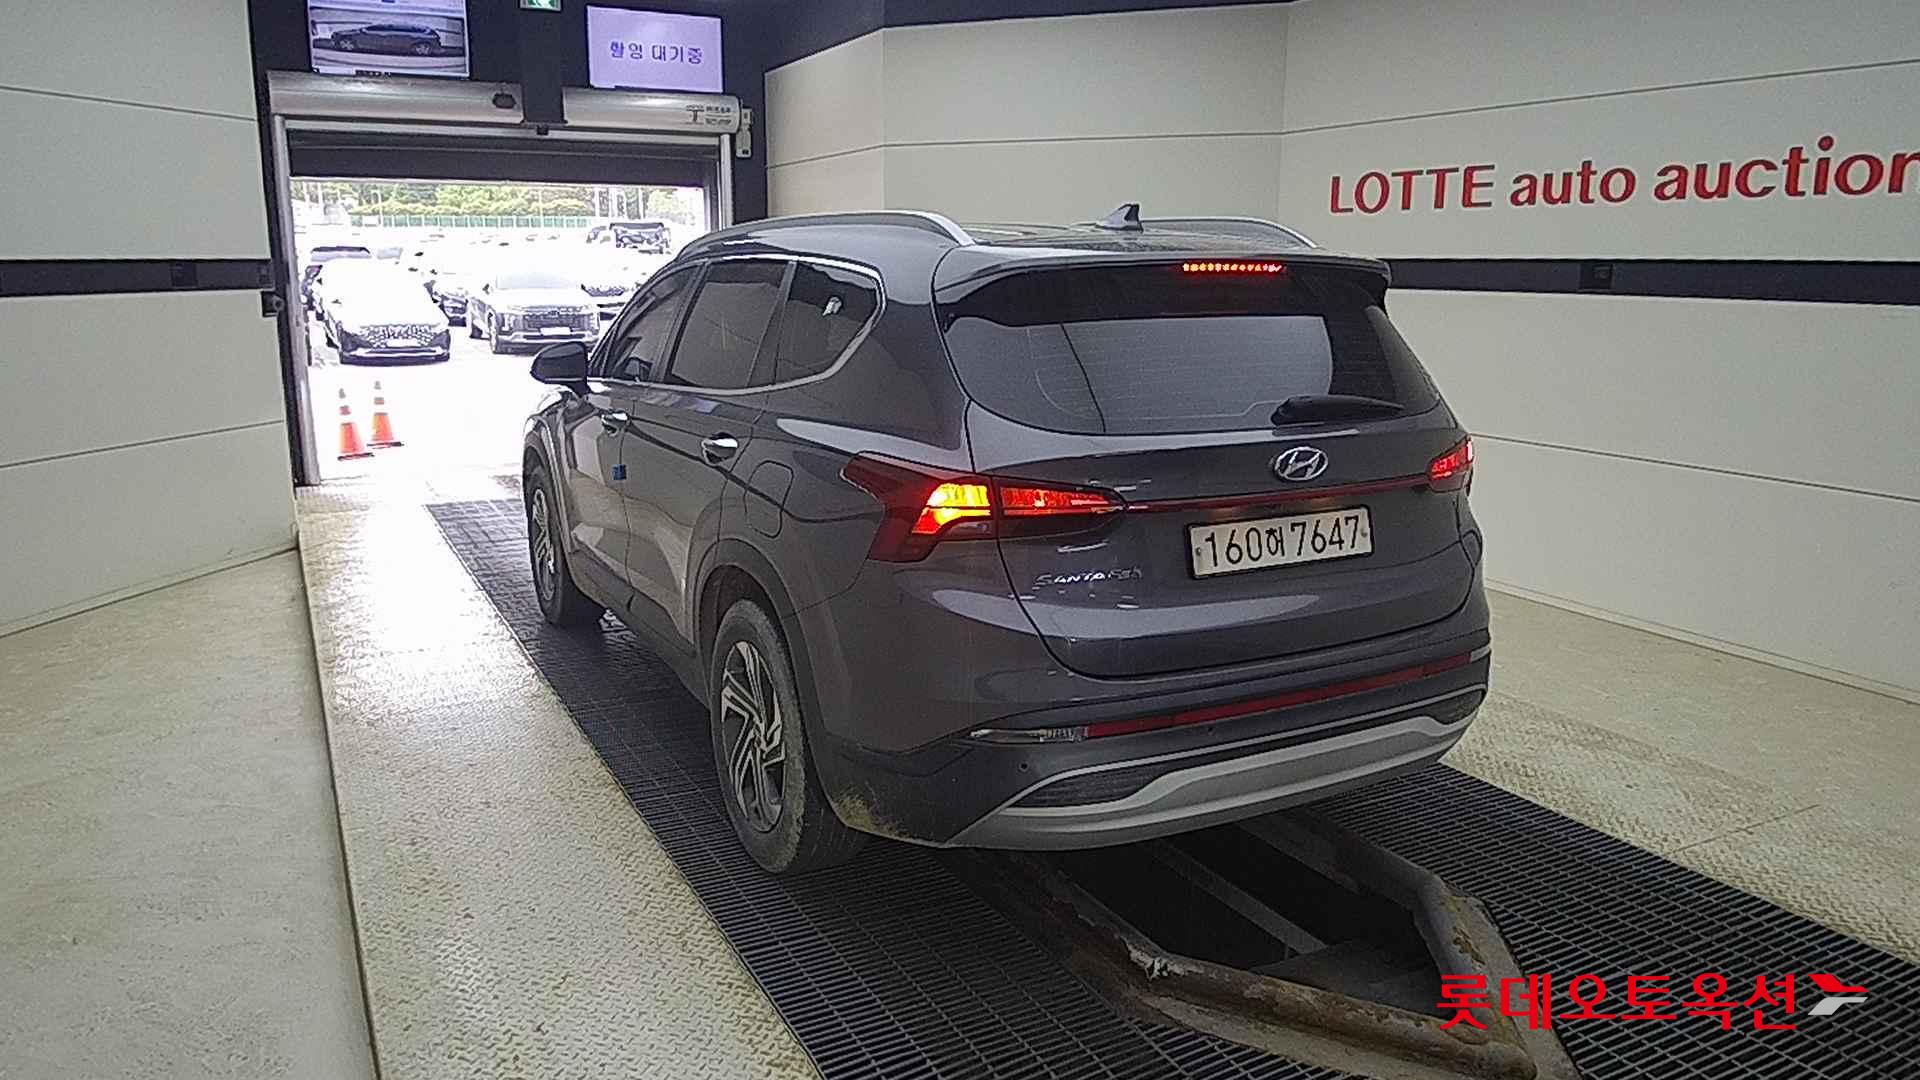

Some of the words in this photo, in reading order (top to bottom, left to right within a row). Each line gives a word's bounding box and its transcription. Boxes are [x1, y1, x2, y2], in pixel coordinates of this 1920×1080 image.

[652, 45, 702, 65] 대기중
[1330, 164, 1495, 213] LOTTE
[1510, 160, 1636, 206] auto
[1654, 135, 1920, 201] auction
[1034, 571, 1106, 584] SANTA
